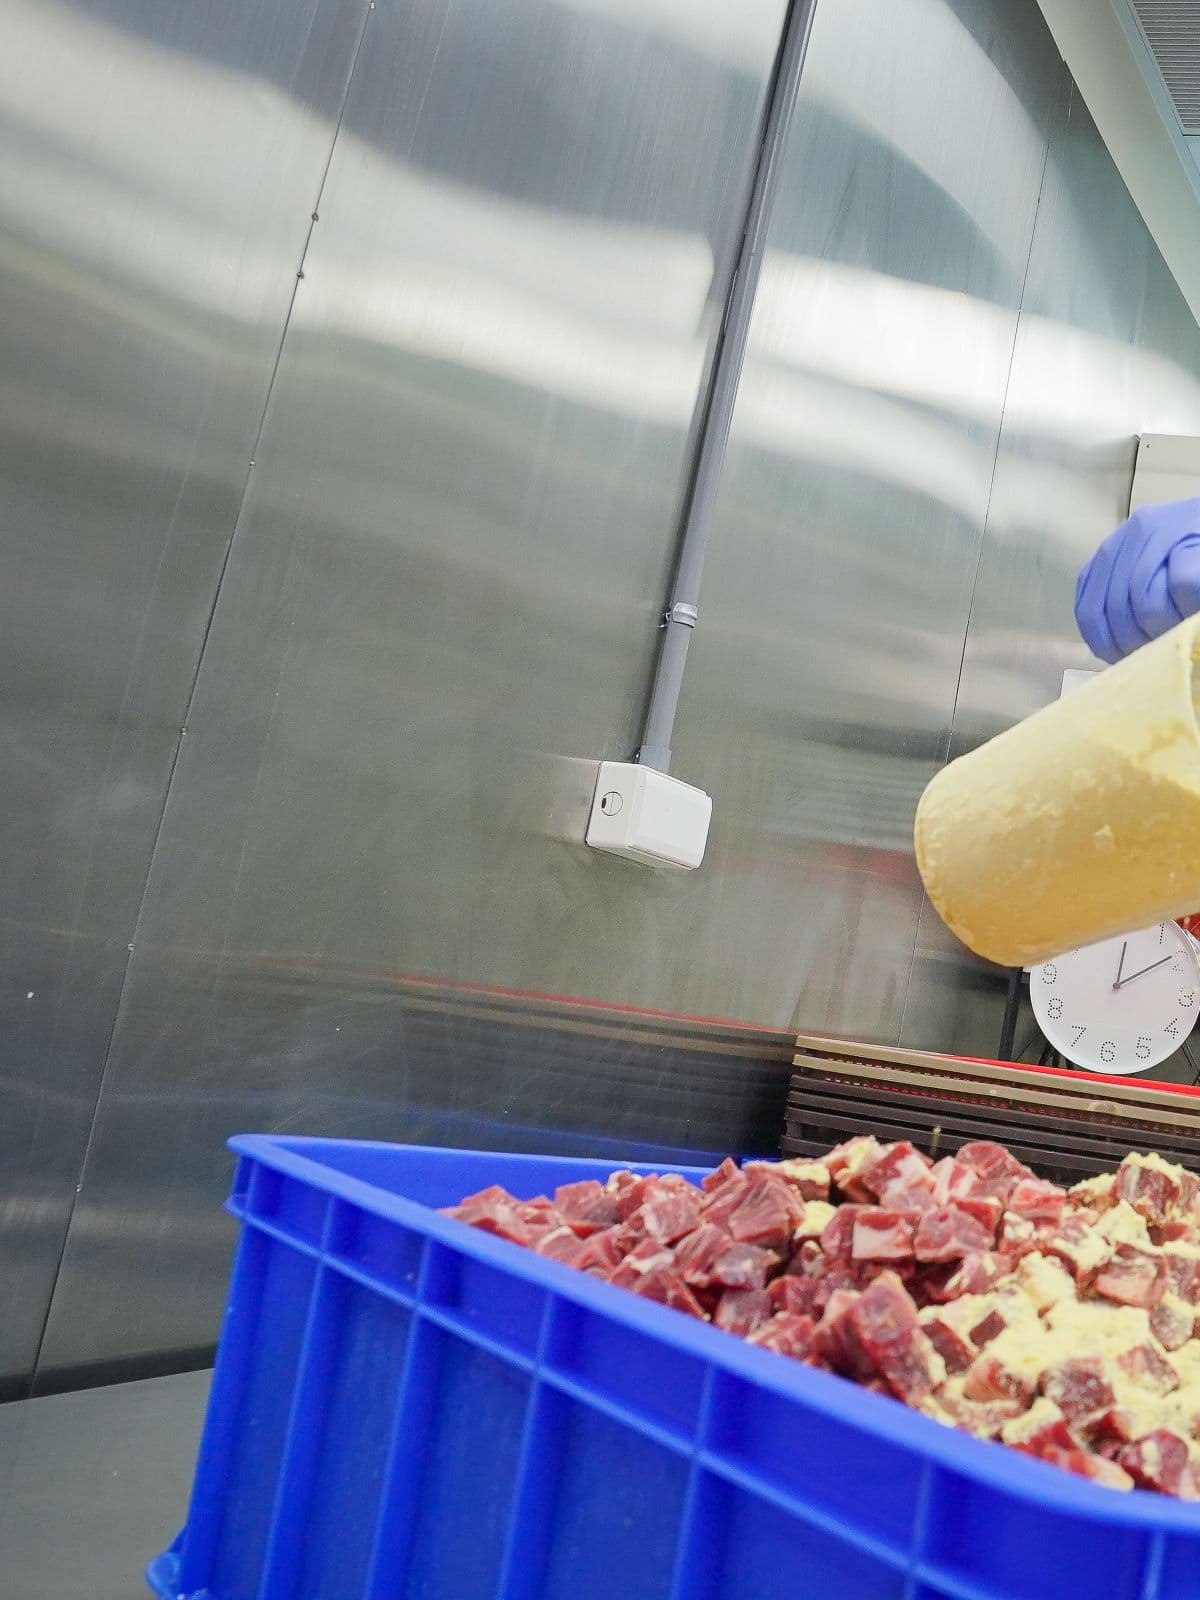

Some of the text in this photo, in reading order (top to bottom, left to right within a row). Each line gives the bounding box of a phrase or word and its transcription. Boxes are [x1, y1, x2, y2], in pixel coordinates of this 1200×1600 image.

[1159, 922, 1166, 945] 1
[1171, 950, 1190, 973] 2
[1041, 963, 1058, 985] 9
[1047, 997, 1063, 1020] 8
[1178, 986, 1195, 1008] 3
[1071, 1025, 1087, 1048] 7
[1163, 1017, 1180, 1040] 4
[1100, 1040, 1116, 1063] 6
[1135, 1036, 1152, 1059] 5
